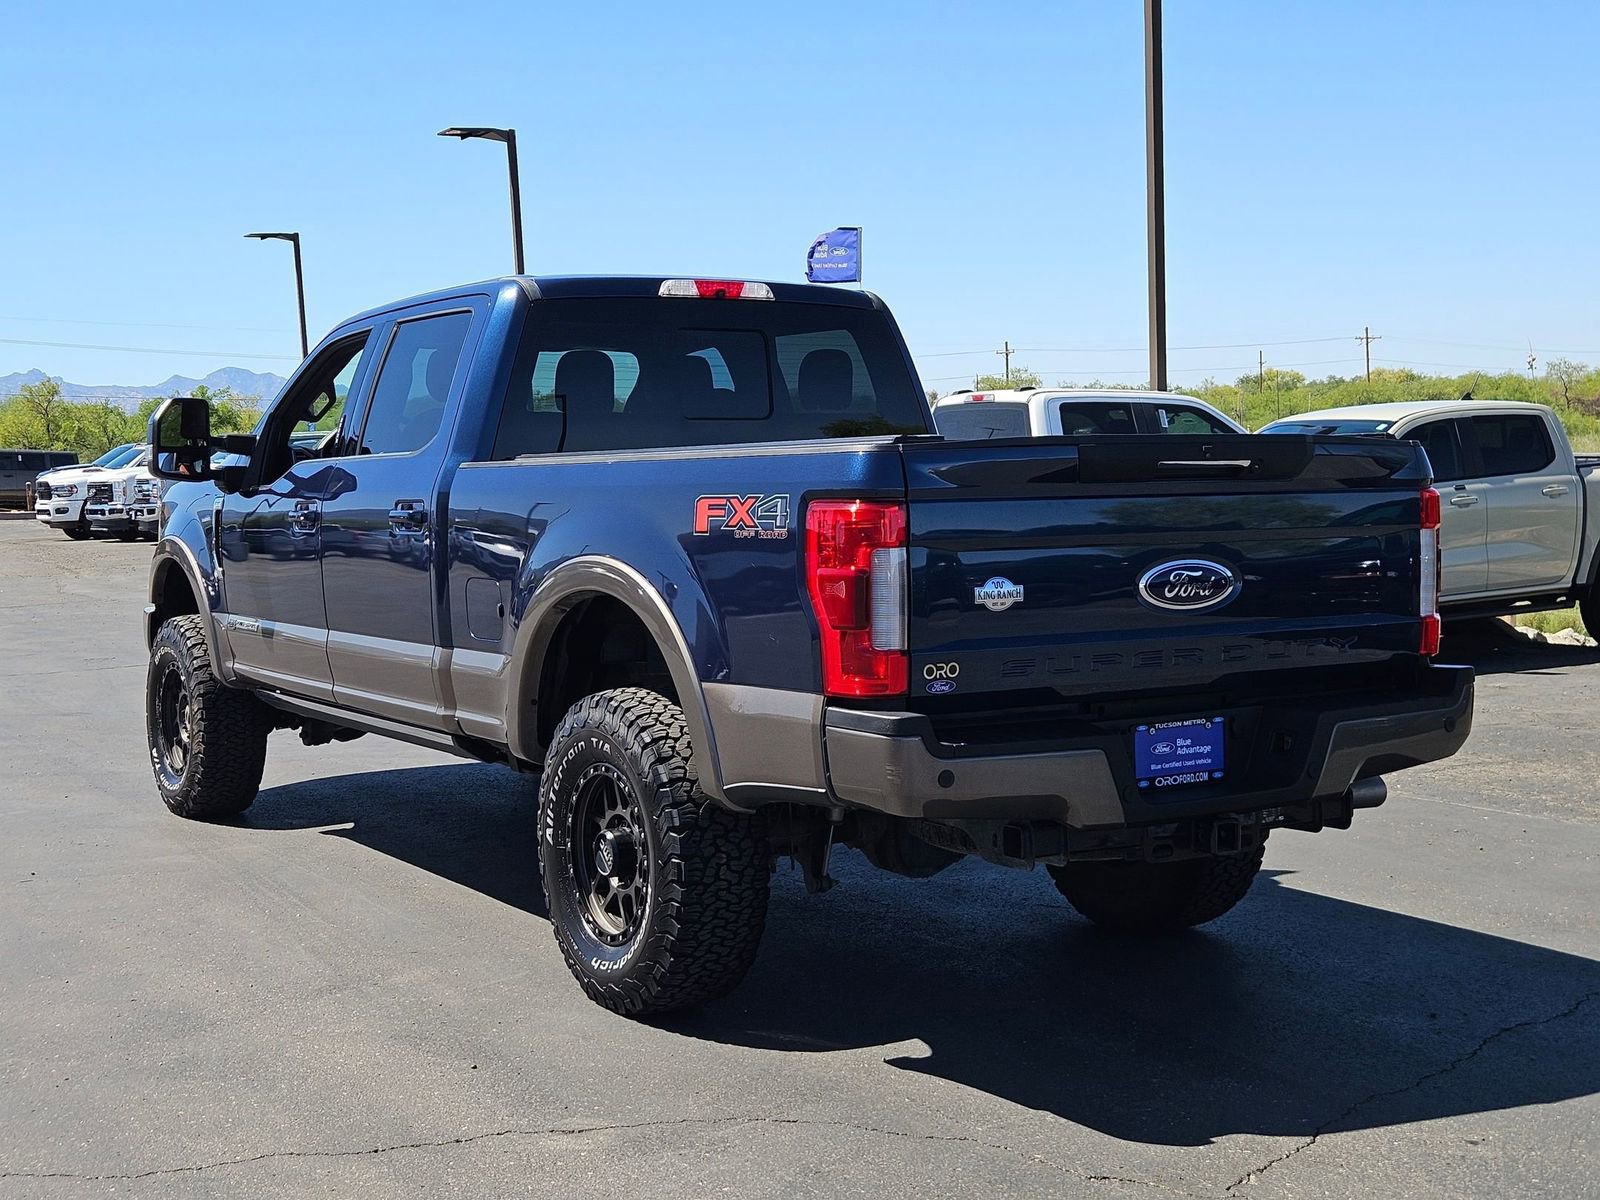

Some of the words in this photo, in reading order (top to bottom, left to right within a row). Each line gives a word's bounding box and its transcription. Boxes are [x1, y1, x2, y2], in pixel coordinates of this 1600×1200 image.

[693, 494, 790, 536] FX4
[734, 530, 756, 539] OFF
[758, 530, 788, 539] ROAD
[1164, 570, 1216, 598] Ford
[977, 589, 996, 601] KING
[997, 587, 1021, 600] RANCH
[1000, 648, 1203, 677] SUPER
[1221, 636, 1359, 661] DUTY
[923, 662, 960, 680] ORO
[1155, 721, 1182, 729] TUCSON
[1183, 718, 1206, 726] METRO
[1176, 738, 1192, 746] Blue
[1176, 744, 1212, 755] Advantage
[1162, 760, 1182, 768] Certified
[1155, 772, 1209, 787] OROFORD.COM
[545, 740, 586, 846] All-Terrain
[590, 737, 612, 755] T/A
